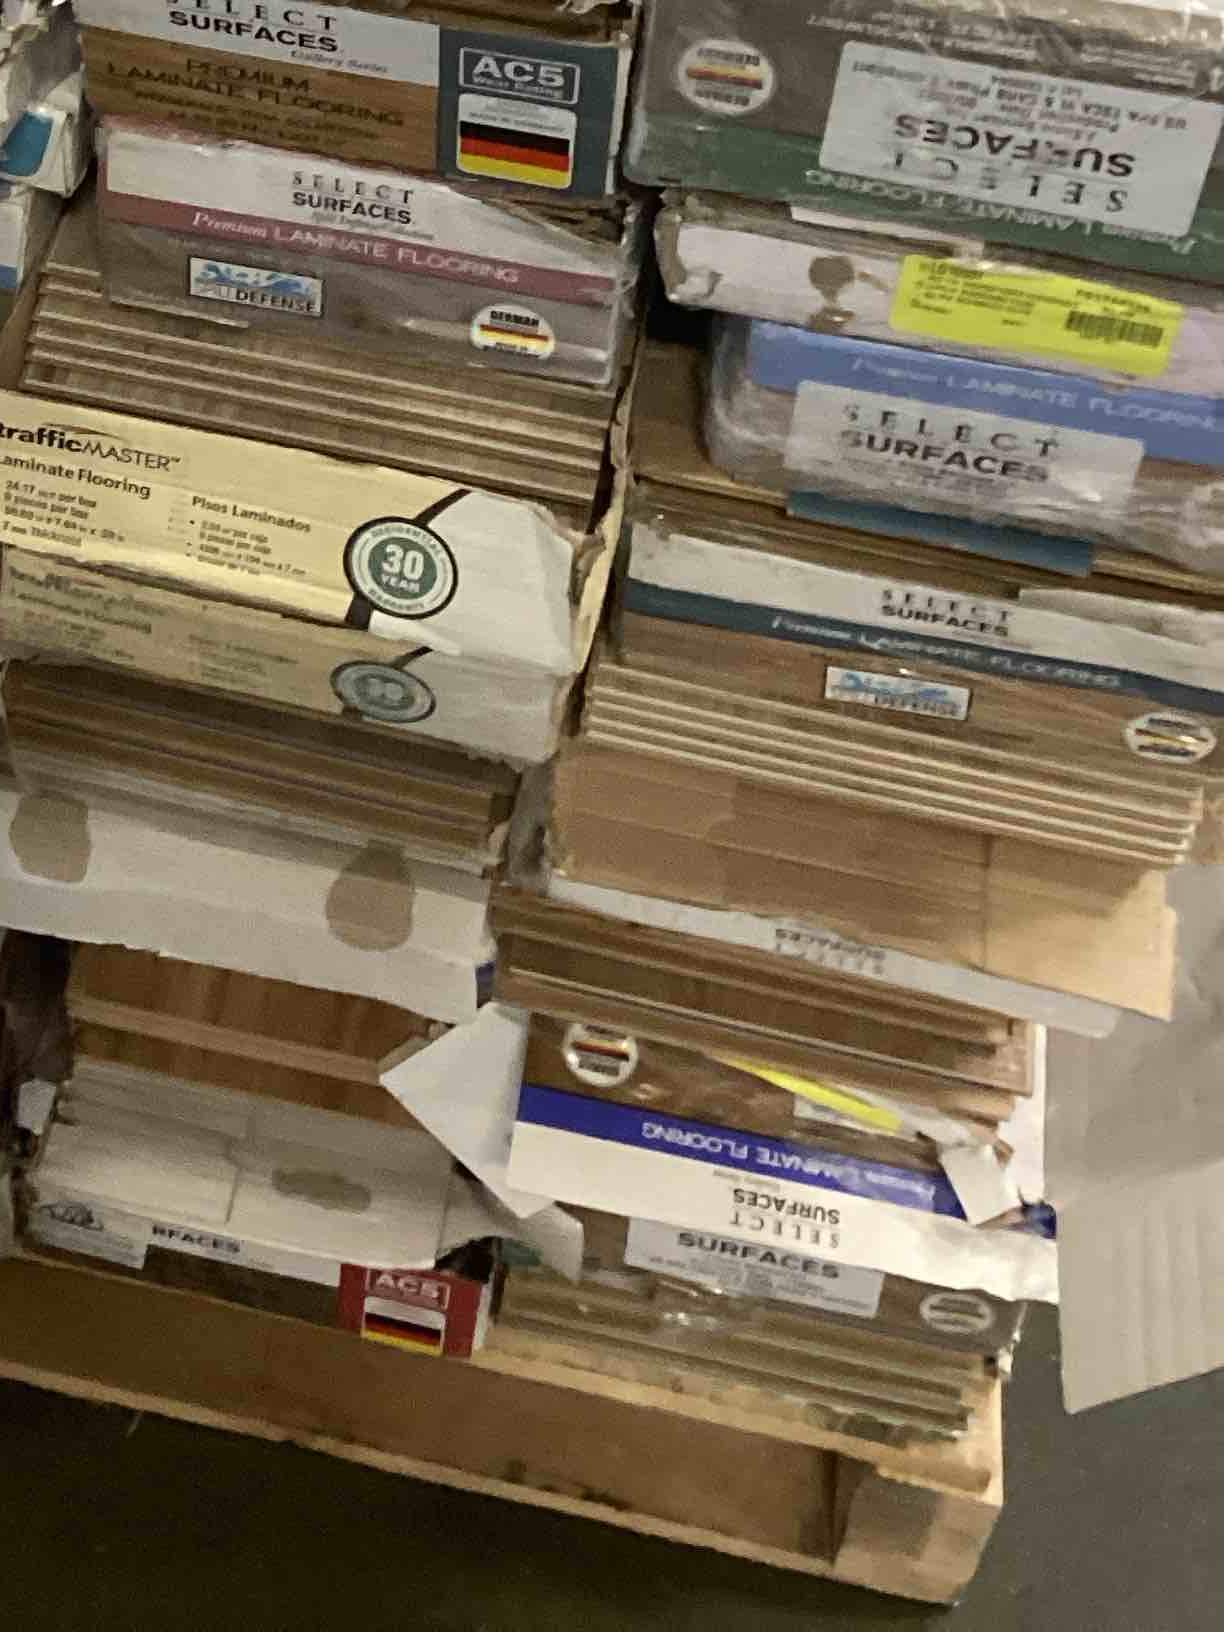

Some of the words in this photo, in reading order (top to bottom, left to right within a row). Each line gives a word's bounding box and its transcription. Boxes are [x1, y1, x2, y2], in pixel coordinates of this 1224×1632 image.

[168, 10, 339, 54] SURFACES
[472, 54, 566, 88] AC5
[291, 170, 416, 205] SELECT
[292, 191, 412, 226] SURFACES
[193, 210, 268, 240] Premium
[275, 226, 388, 261] LAMINATE
[397, 247, 521, 285] FLOORING
[841, 404, 1060, 456] SELECT
[839, 429, 1050, 482] SURFACES
[78, 467, 152, 500] Flooring
[192, 494, 229, 516] Pisos
[232, 502, 312, 534] Laminados
[381, 543, 425, 581] 30
[881, 604, 1009, 637] SURFACES
[641, 1120, 749, 1159] FLOORING
[733, 1187, 841, 1225] SURFACES
[729, 1211, 841, 1248] SELECT
[677, 1231, 840, 1280] SURFACES
